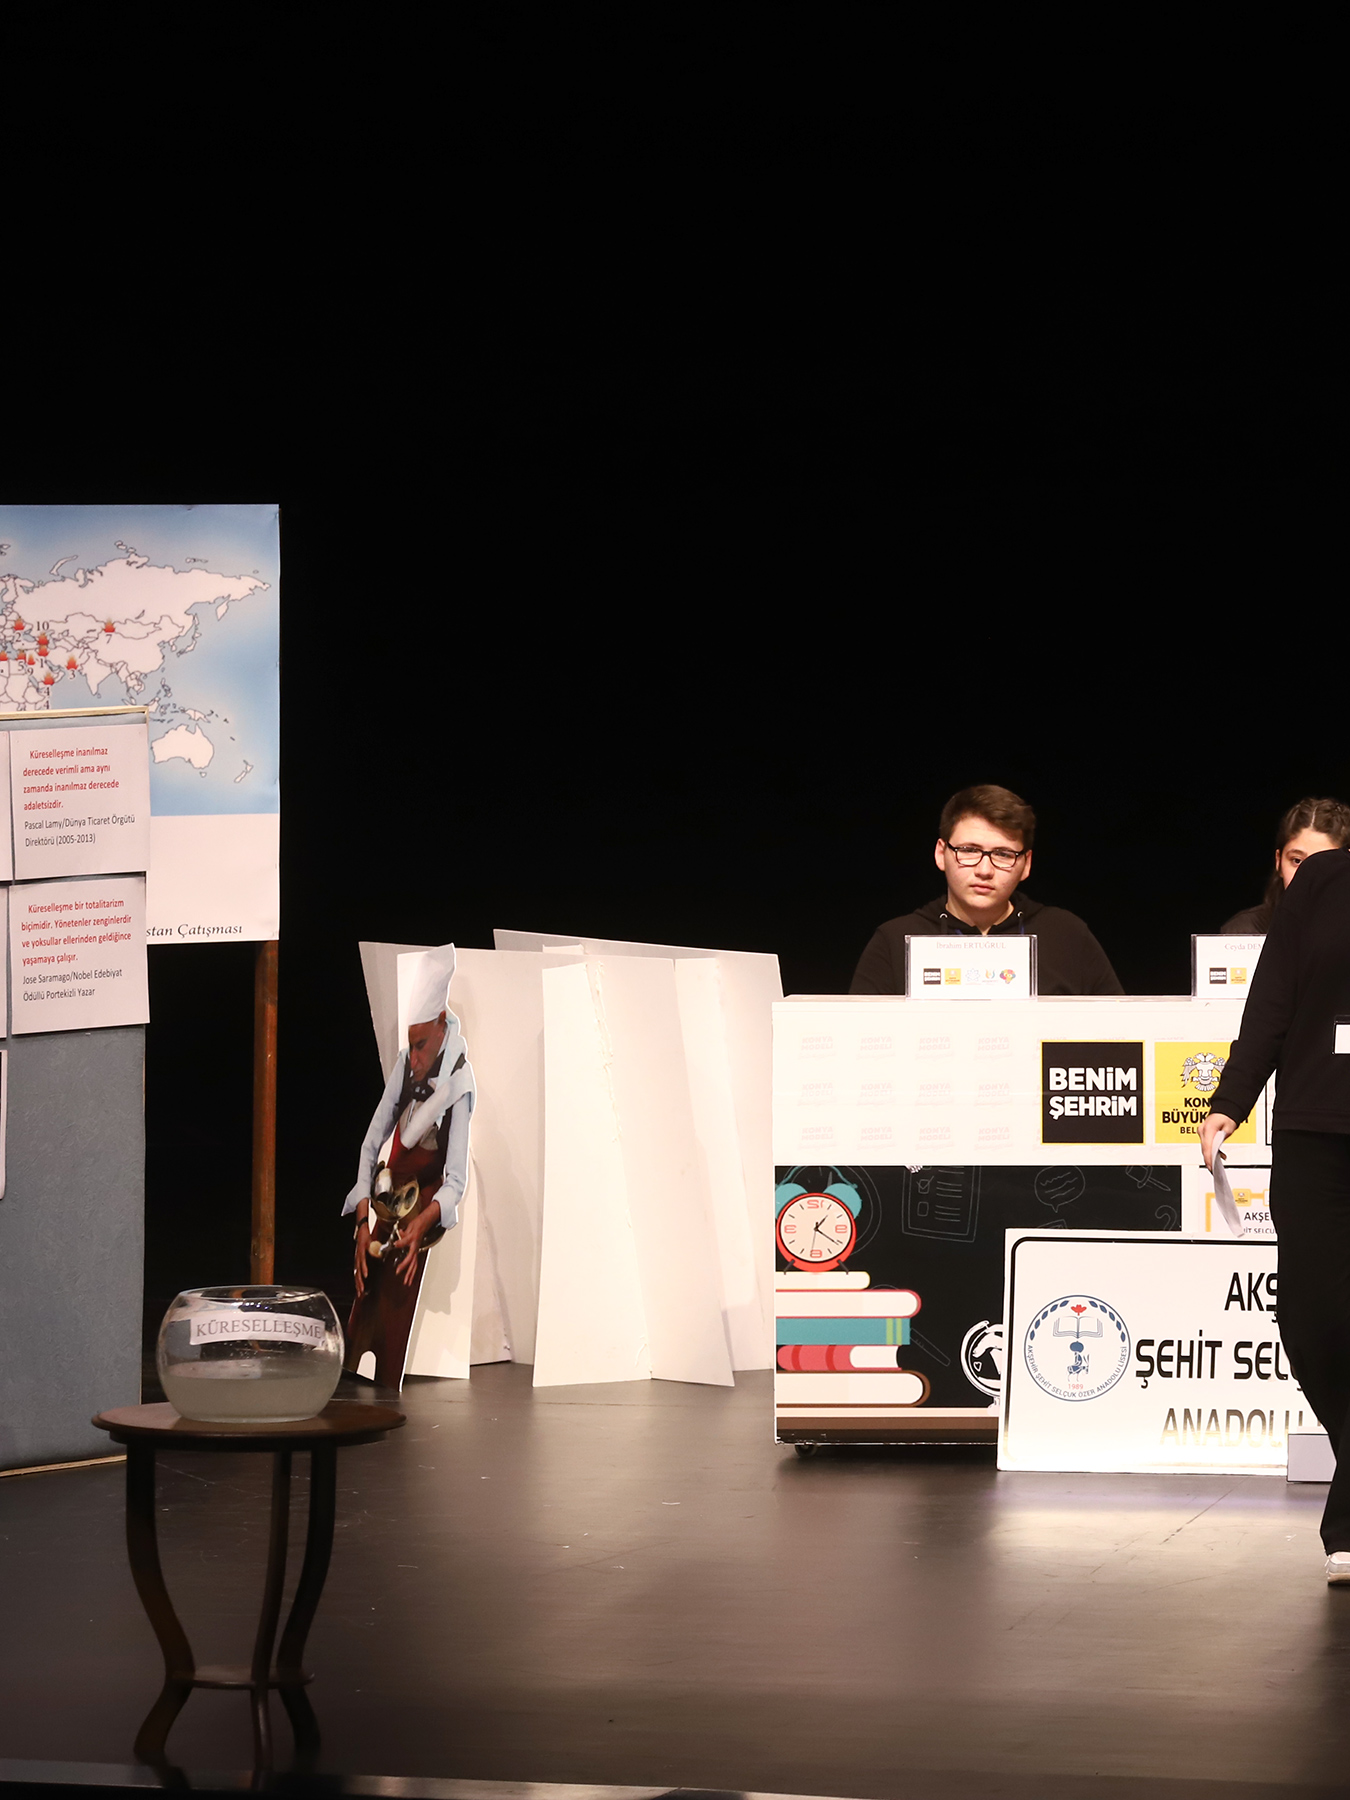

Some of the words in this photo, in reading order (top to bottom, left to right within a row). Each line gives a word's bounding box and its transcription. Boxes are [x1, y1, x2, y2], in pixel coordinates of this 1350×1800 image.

[37, 621, 49, 631] 10
[106, 634, 112, 644] 7
[18, 661, 24, 671] 5
[27, 667, 33, 676] 9
[70, 670, 76, 679] 3
[44, 687, 50, 696] 4
[30, 749, 75, 759] Küreselleşme
[76, 747, 108, 757] inanılmaz
[23, 766, 54, 776] derecede
[56, 764, 79, 774] verimli
[96, 764, 110, 774] aynı
[24, 783, 53, 793] zamanda
[55, 781, 86, 791] inanılmaz
[88, 779, 119, 789] derecede
[24, 800, 64, 810] adaletsizdir.
[25, 820, 44, 830] Pascal
[45, 818, 86, 829] Lamy/Dünya
[88, 816, 110, 825] Ticaret
[112, 814, 135, 825] Örgütü
[25, 837, 54, 847] Direktörü
[56, 833, 96, 846] (2005-2013)
[28, 903, 73, 914] Küreselleşme
[74, 901, 84, 910] bir
[86, 899, 124, 909] totalitarizm
[22, 922, 52, 932] biçimidir.
[54, 919, 91, 929] Yönetenler
[93, 915, 132, 927] zenginlerdir
[146, 926, 172, 936] stan
[177, 924, 242, 938] Çatışması
[31, 937, 61, 949] yoksullar
[63, 934, 97, 945] ellerinden
[98, 932, 131, 944] geldiğince
[964, 941, 1006, 949] ERTUĞRUL
[22, 954, 55, 966] yaşamaya
[57, 952, 78, 964] çalışır.
[23, 976, 36, 985] Jose
[38, 971, 92, 984] Saramago/Nobel
[94, 968, 122, 979] Edebiyat
[23, 991, 45, 1002] Ödüllü
[46, 989, 76, 999] Portekizli
[78, 988, 95, 996] Yazar
[1049, 1067, 1136, 1090] BENİM
[1049, 1096, 1137, 1120] ŞEHRİM
[1184, 1098, 1210, 1107] KON
[1162, 1109, 1208, 1123] BÜYÜK
[1244, 1212, 1269, 1223] AKŞE
[1224, 1272, 1278, 1323] AKŞ
[196, 1319, 322, 1338] KÜRESELLEŞME
[1135, 1330, 1222, 1389] ŞEHİT
[1233, 1341, 1289, 1381] SEL
[1027, 1344, 1038, 1374] AKŞEHİR
[1035, 1373, 1052, 1390] ŞEHİT
[1051, 1386, 1077, 1398] SELÇUK
[1078, 1389, 1095, 1398] ÖZER
[1096, 1368, 1121, 1393] ANADOLU
[1117, 1346, 1127, 1368] LİSESİ
